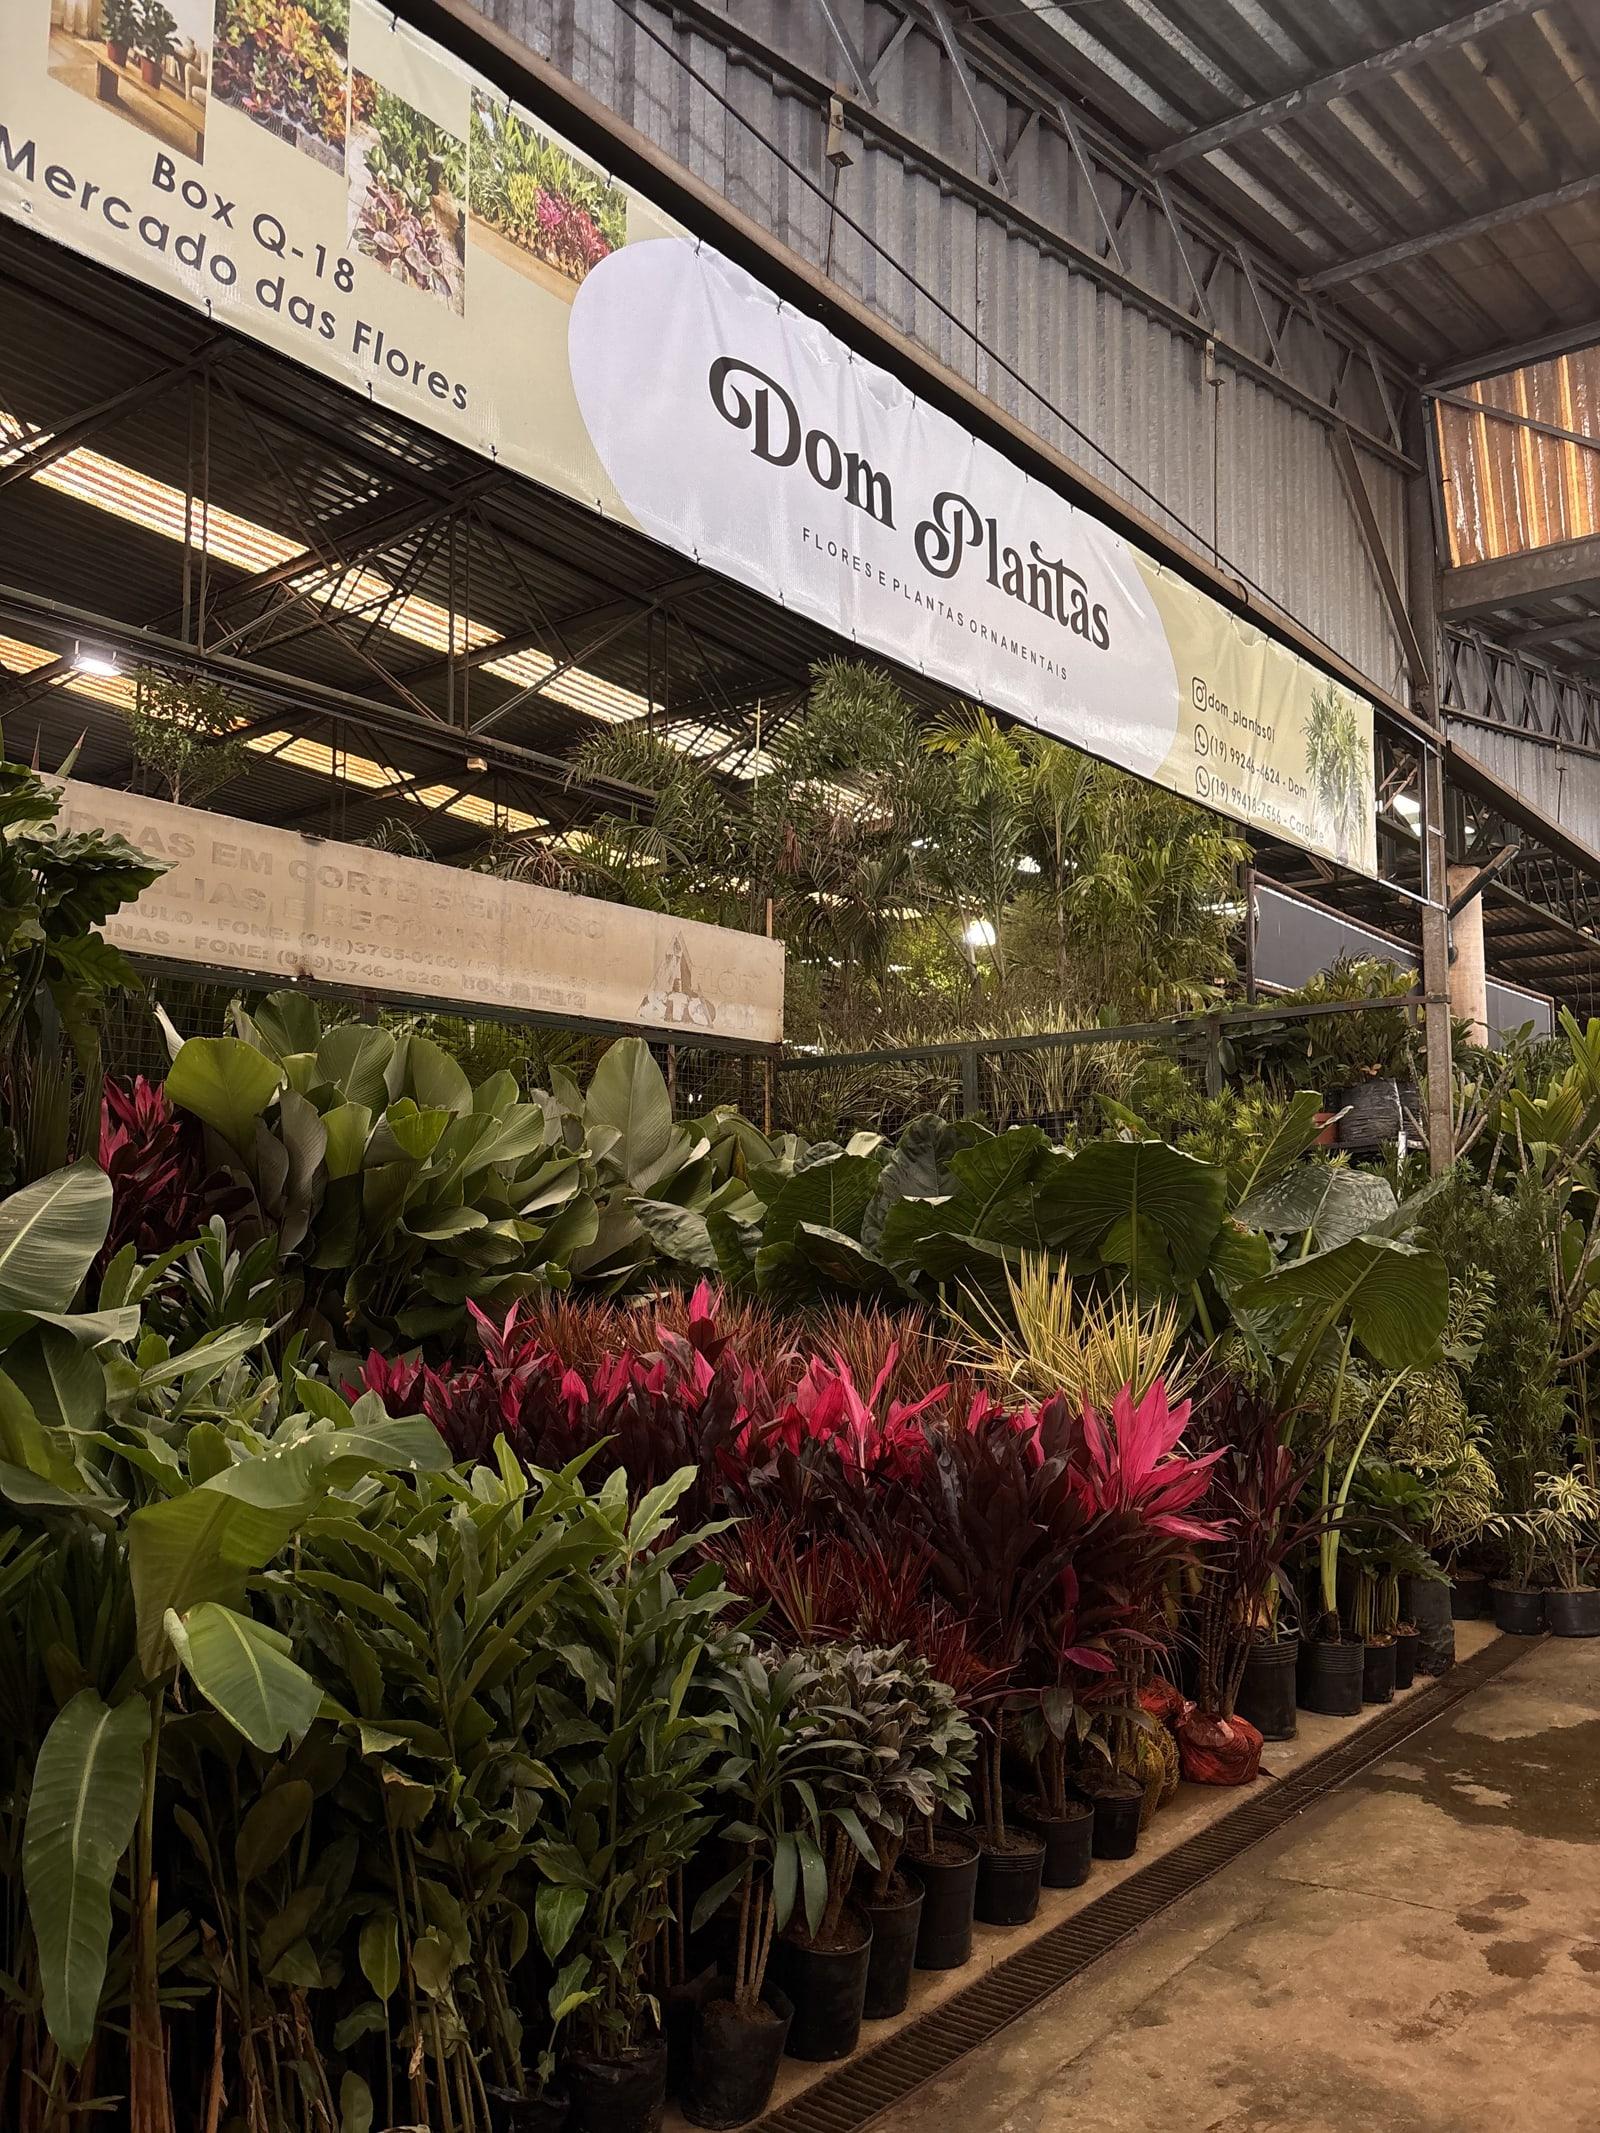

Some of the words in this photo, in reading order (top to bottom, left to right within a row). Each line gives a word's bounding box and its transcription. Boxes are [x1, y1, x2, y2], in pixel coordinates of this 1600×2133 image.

[152, 152, 236, 229] Box
[252, 213, 356, 294] Q-18
[0, 124, 237, 286] Mercado
[255, 277, 335, 339] das
[352, 321, 468, 410] Flores
[708, 356, 897, 530] Dom
[914, 491, 1110, 651] Plantas
[803, 527, 872, 578] FLORES
[893, 578, 964, 627] PLANTAS
[969, 619, 1068, 680] ORNAMENTAIS
[1208, 693, 1275, 744] dom_plantas01
[1210, 736, 1227, 763] (19)
[1230, 748, 1280, 786] 99246-4624
[1288, 777, 1307, 798] Dom
[1211, 777, 1229, 804] (19)
[1232, 788, 1281, 825] 99418-7566
[1289, 815, 1325, 843] Caroline
[211, 841, 273, 876] EM
[194, 936, 270, 960] FONE:
